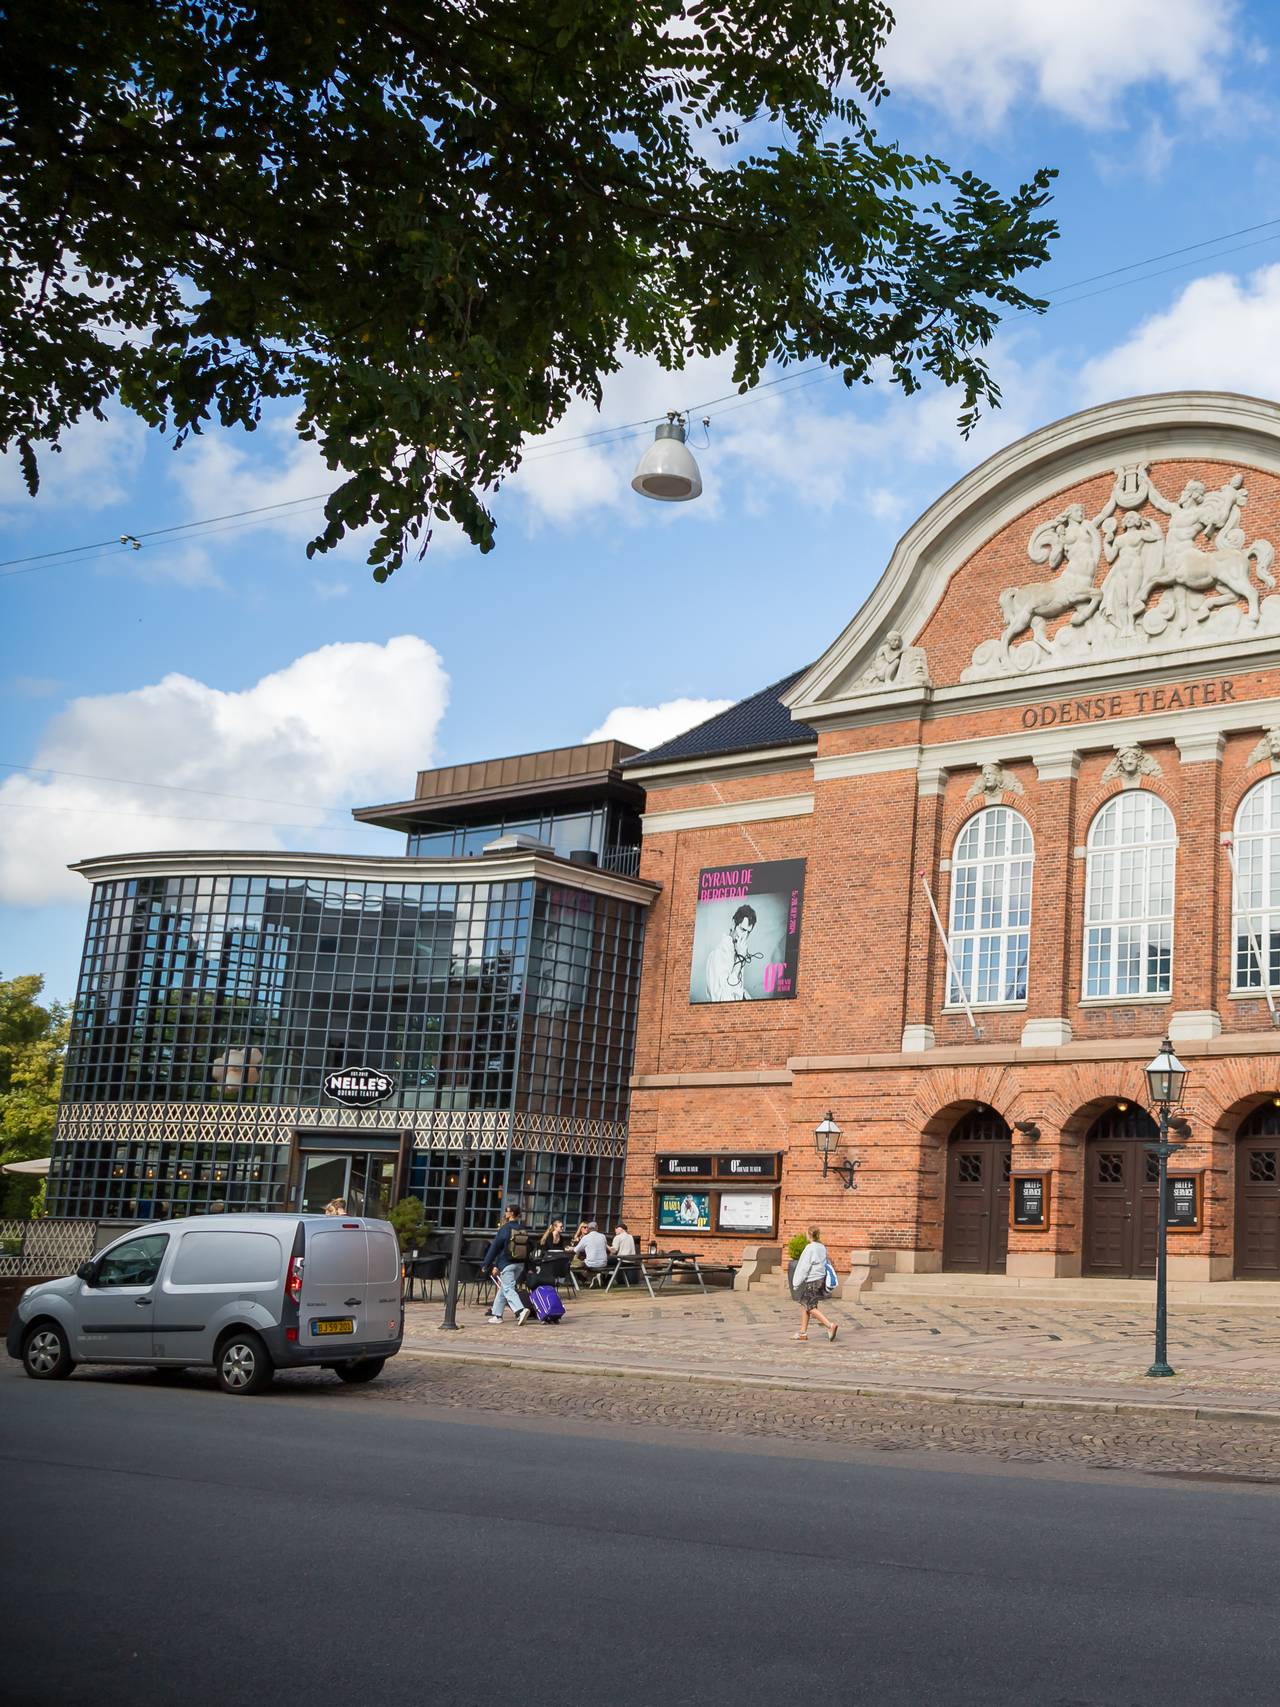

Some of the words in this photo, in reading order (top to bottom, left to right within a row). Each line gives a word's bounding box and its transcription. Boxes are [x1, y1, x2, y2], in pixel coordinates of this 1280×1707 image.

[1021, 695, 1123, 729] ODENSE
[1134, 680, 1236, 713] TEATER
[701, 870, 739, 888] CYRANO
[741, 868, 753, 884] DE
[330, 1076, 387, 1091] NELLE'S
